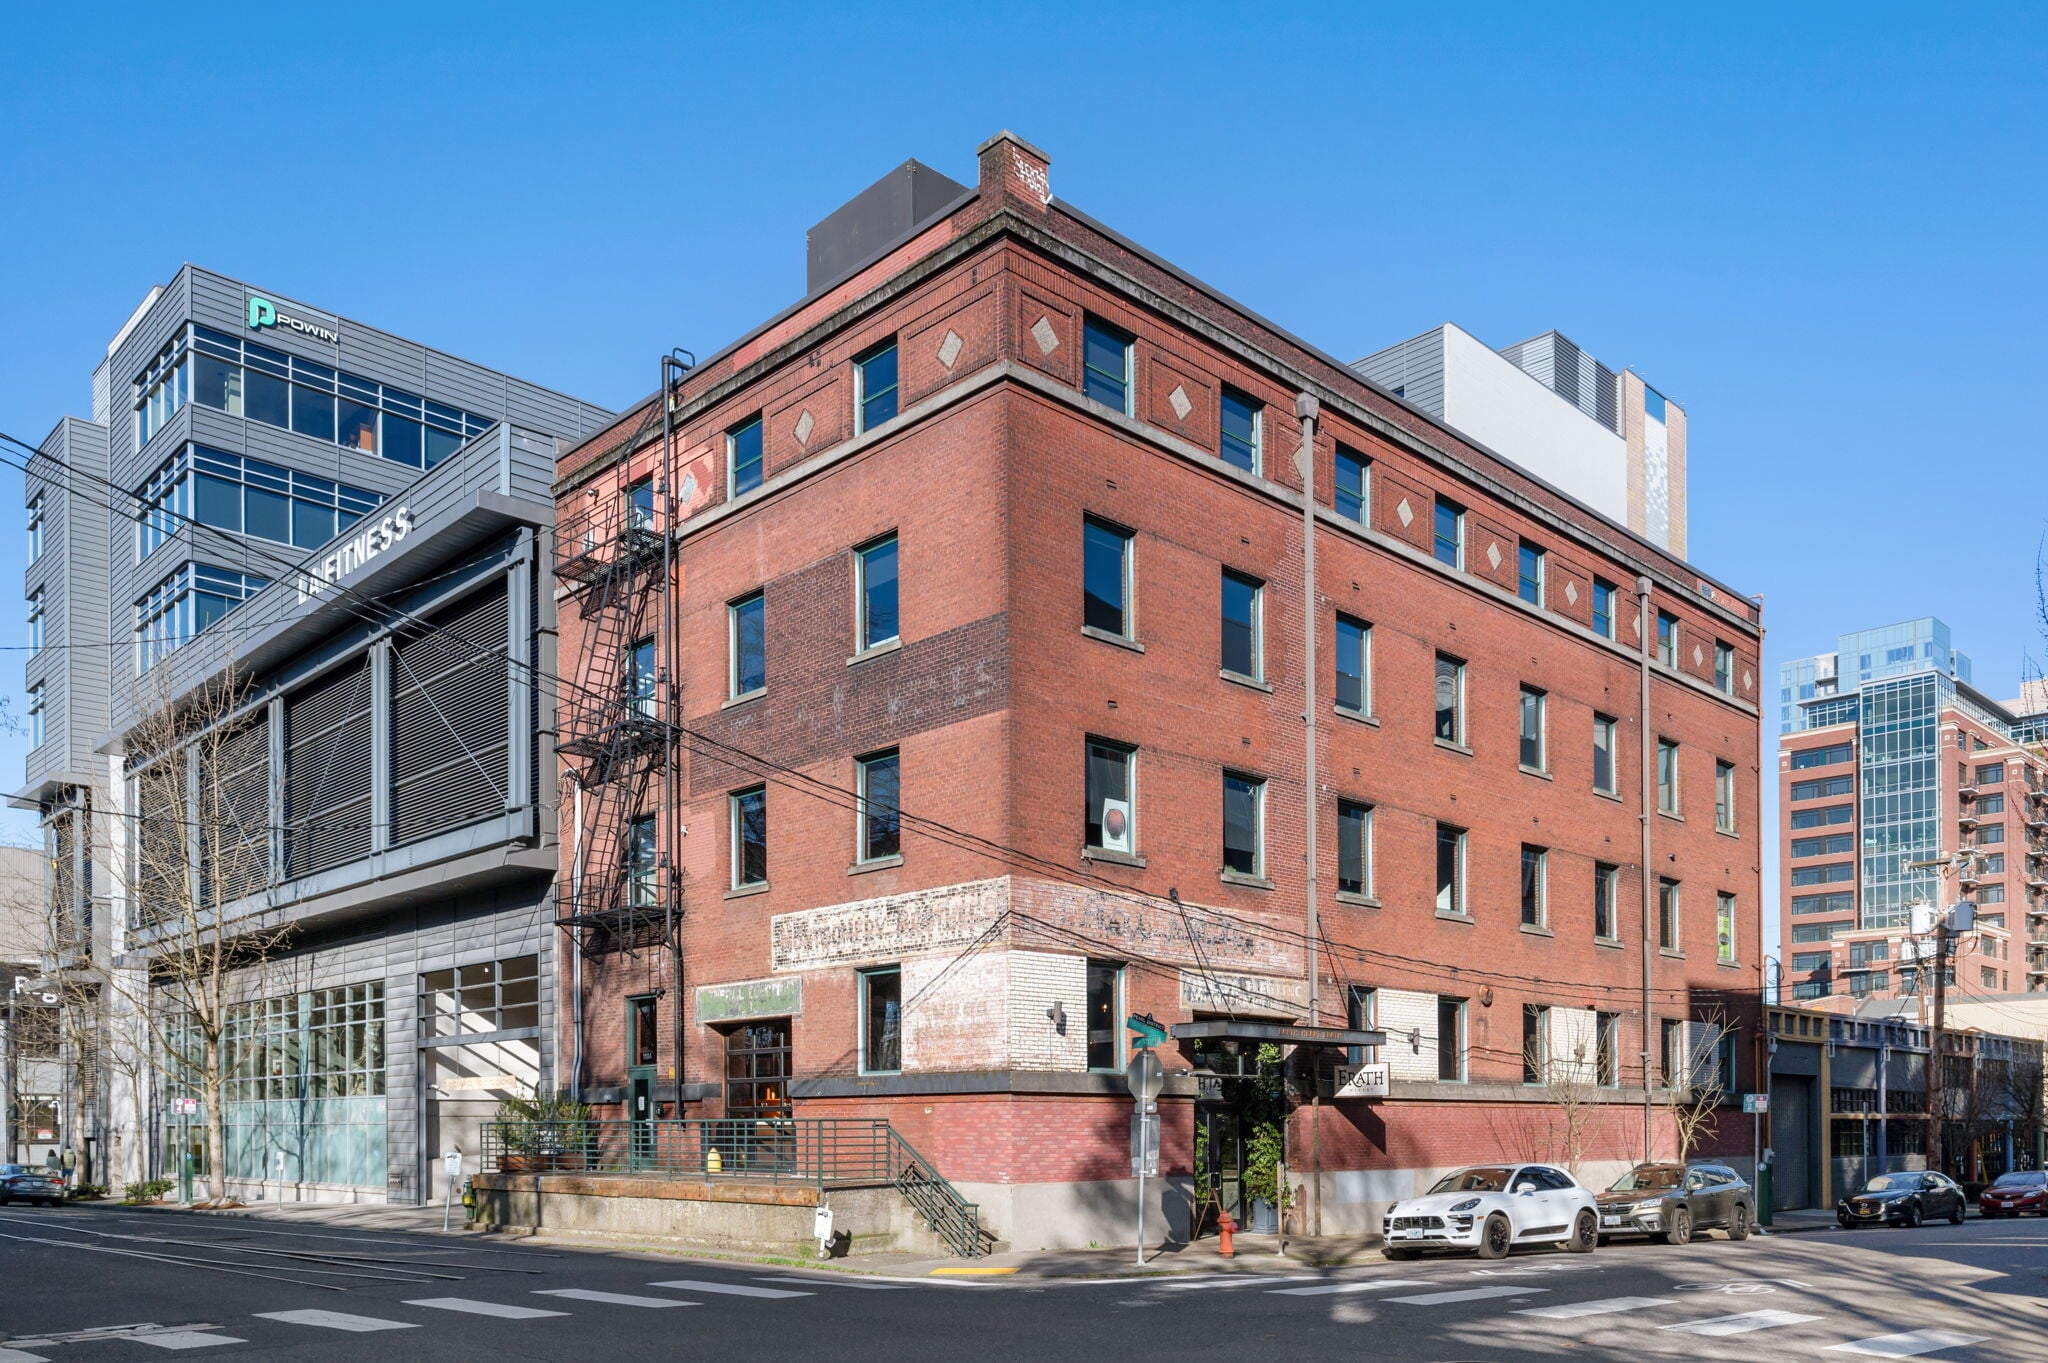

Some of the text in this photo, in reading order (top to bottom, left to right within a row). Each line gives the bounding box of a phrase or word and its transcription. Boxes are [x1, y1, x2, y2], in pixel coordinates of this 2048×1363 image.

[277, 313, 338, 342] POWIN
[325, 506, 409, 588] FITNESS
[1338, 1070, 1384, 1087] ERATH
